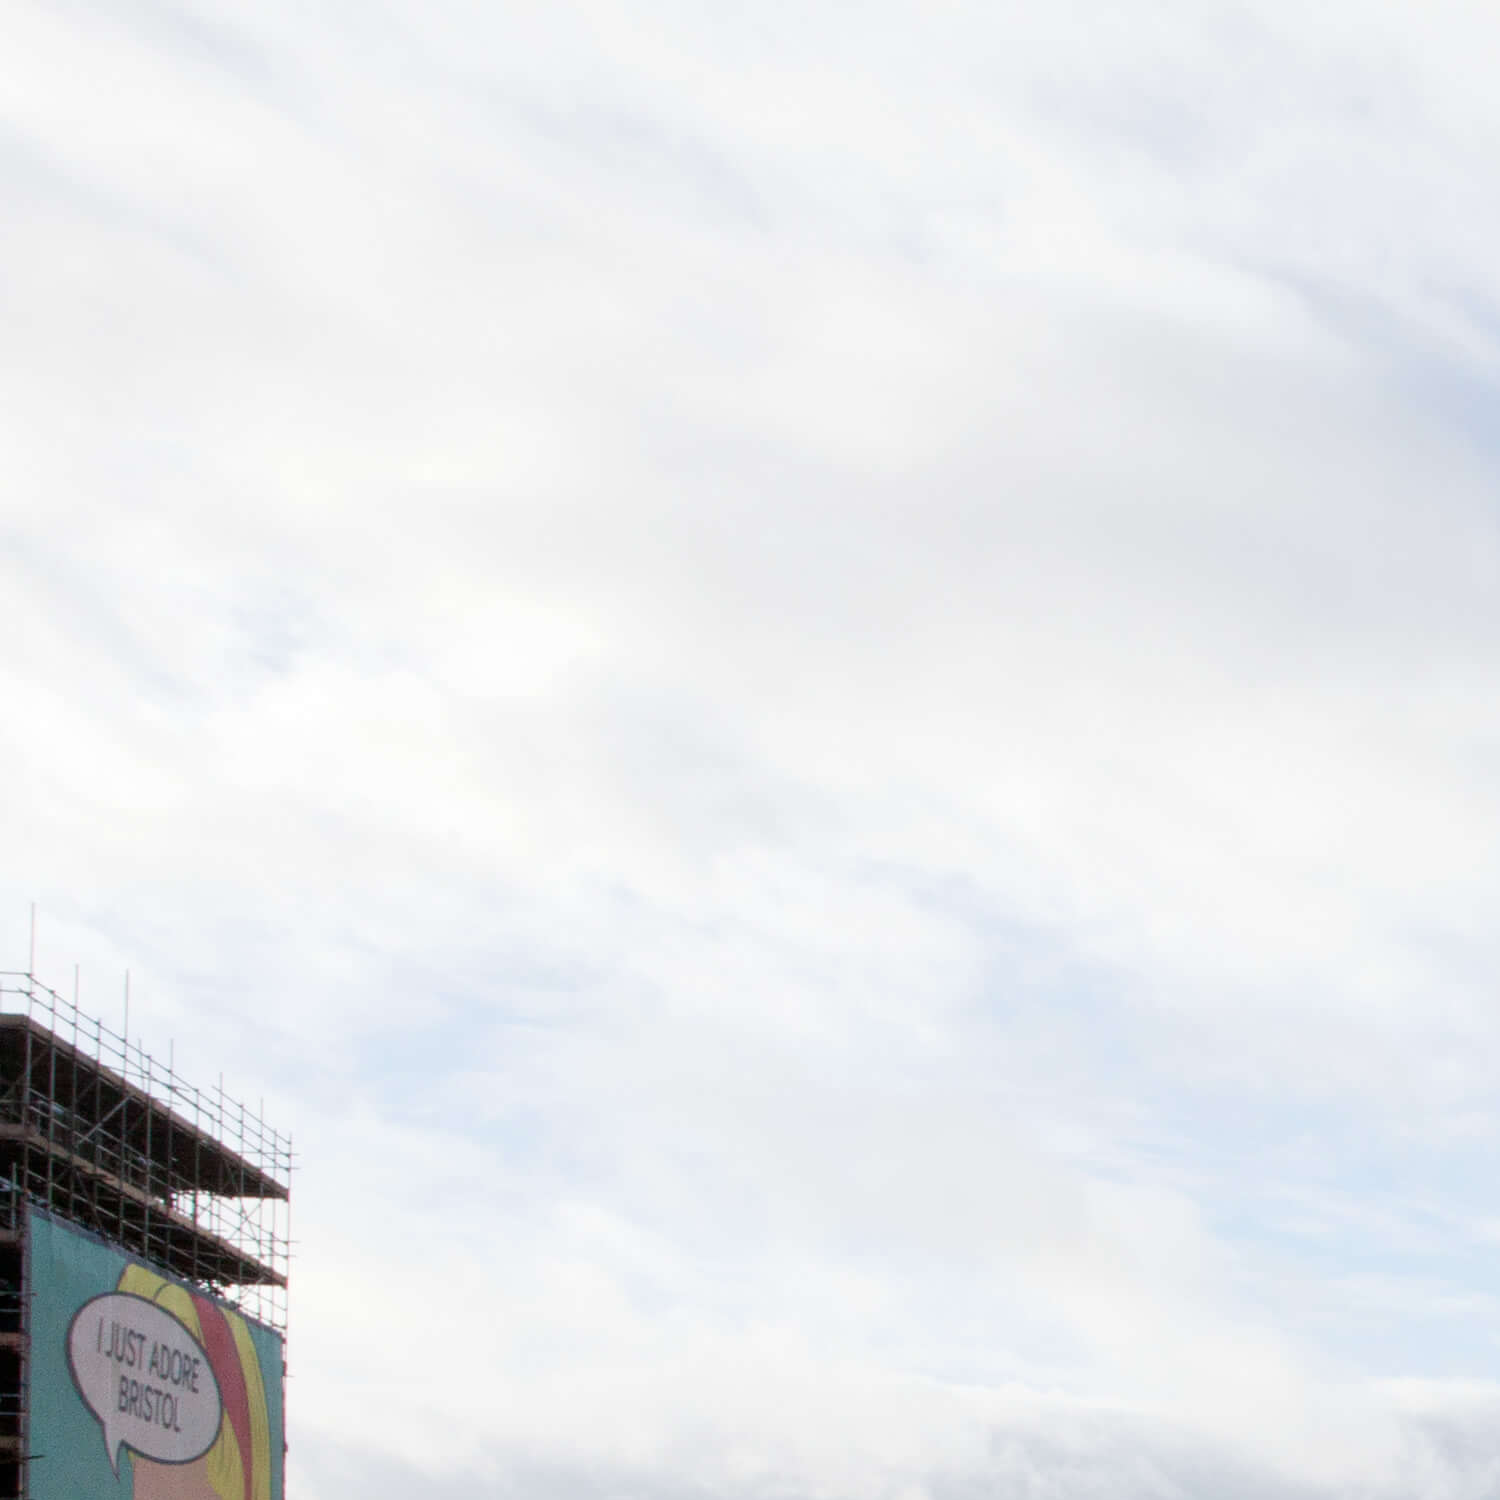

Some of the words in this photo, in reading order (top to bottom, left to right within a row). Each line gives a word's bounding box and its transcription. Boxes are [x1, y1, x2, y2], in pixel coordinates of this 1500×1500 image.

[97, 1318, 104, 1353] I
[104, 1321, 147, 1371] JUST
[149, 1341, 200, 1394] ADORE
[119, 1375, 181, 1432] BRISTOL
